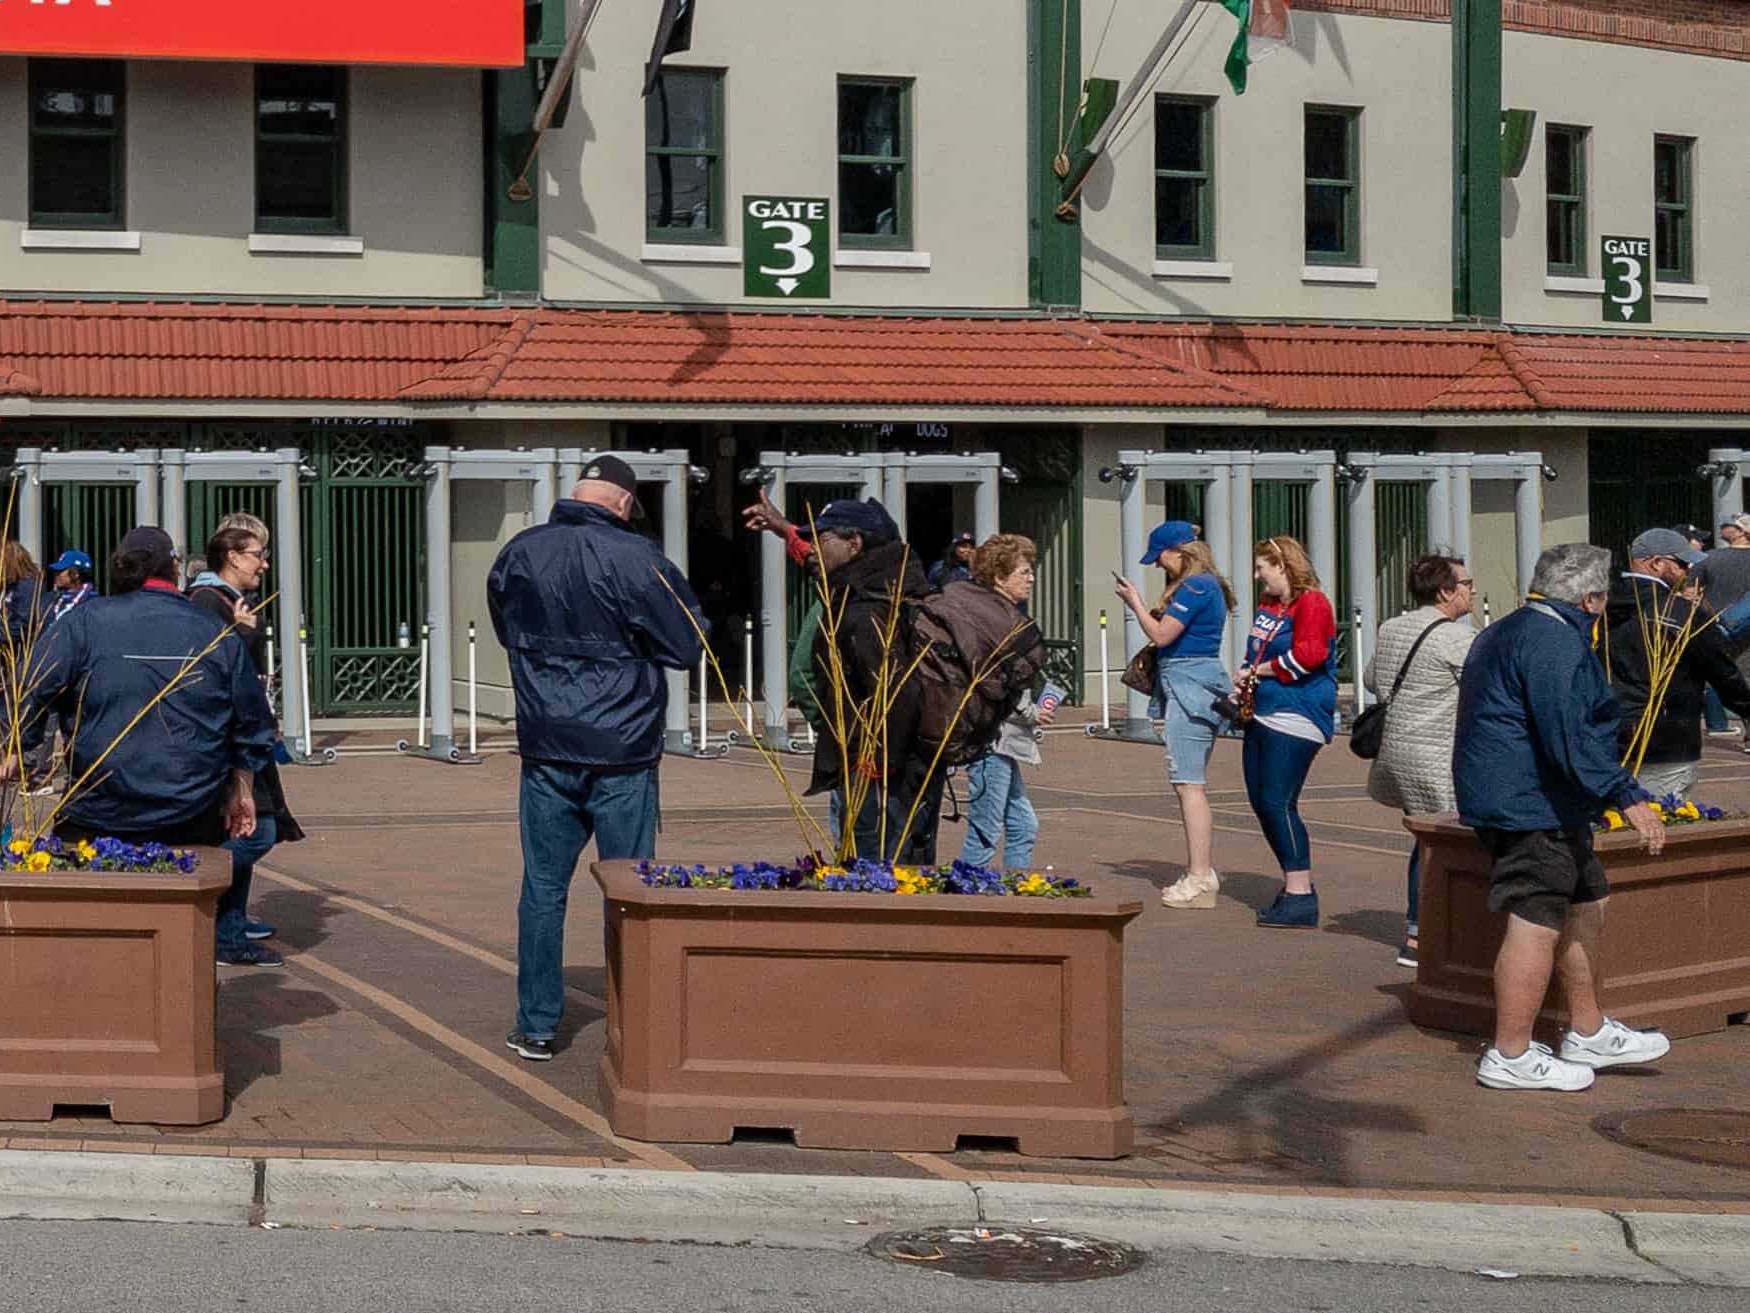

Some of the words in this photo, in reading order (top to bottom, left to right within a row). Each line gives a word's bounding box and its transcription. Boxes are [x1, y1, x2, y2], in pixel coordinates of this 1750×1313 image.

[747, 199, 826, 221] GATE
[759, 219, 816, 276] 3
[1603, 239, 1649, 257] GATE
[1610, 256, 1644, 305] 3
